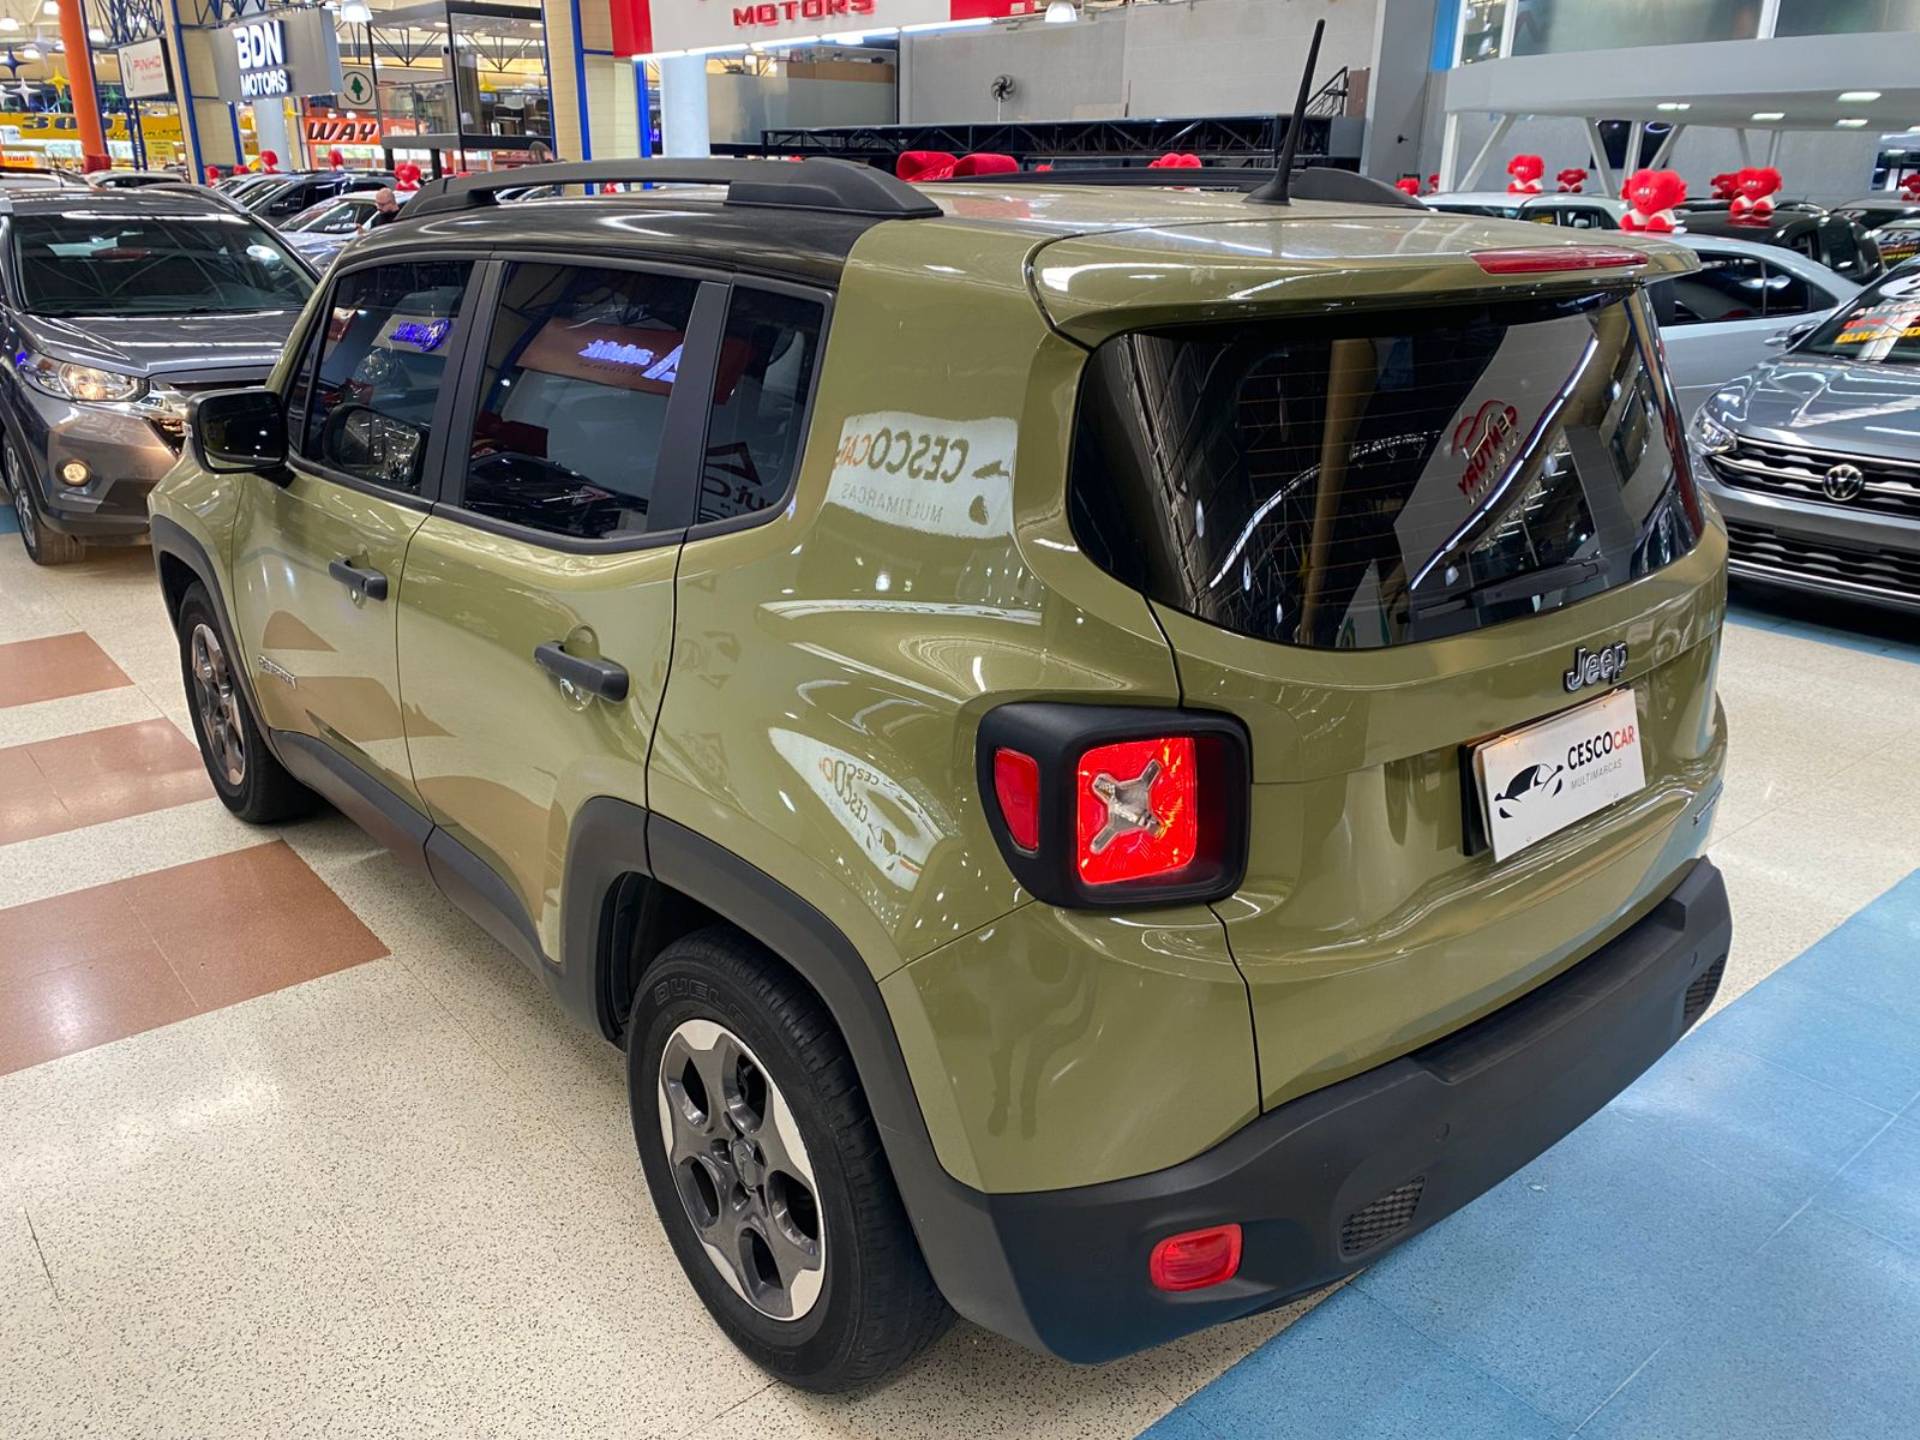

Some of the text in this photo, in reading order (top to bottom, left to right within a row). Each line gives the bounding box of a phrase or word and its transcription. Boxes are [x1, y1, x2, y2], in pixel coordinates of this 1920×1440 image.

[733, 0, 876, 26] MOTORS
[232, 20, 284, 69] BDN
[240, 70, 288, 96] MOTORS
[307, 121, 379, 142] WAY
[1564, 641, 1628, 693] Jeep
[1567, 725, 1635, 771] CESCOCAR
[1570, 758, 1623, 790] MULTIMARCAS
